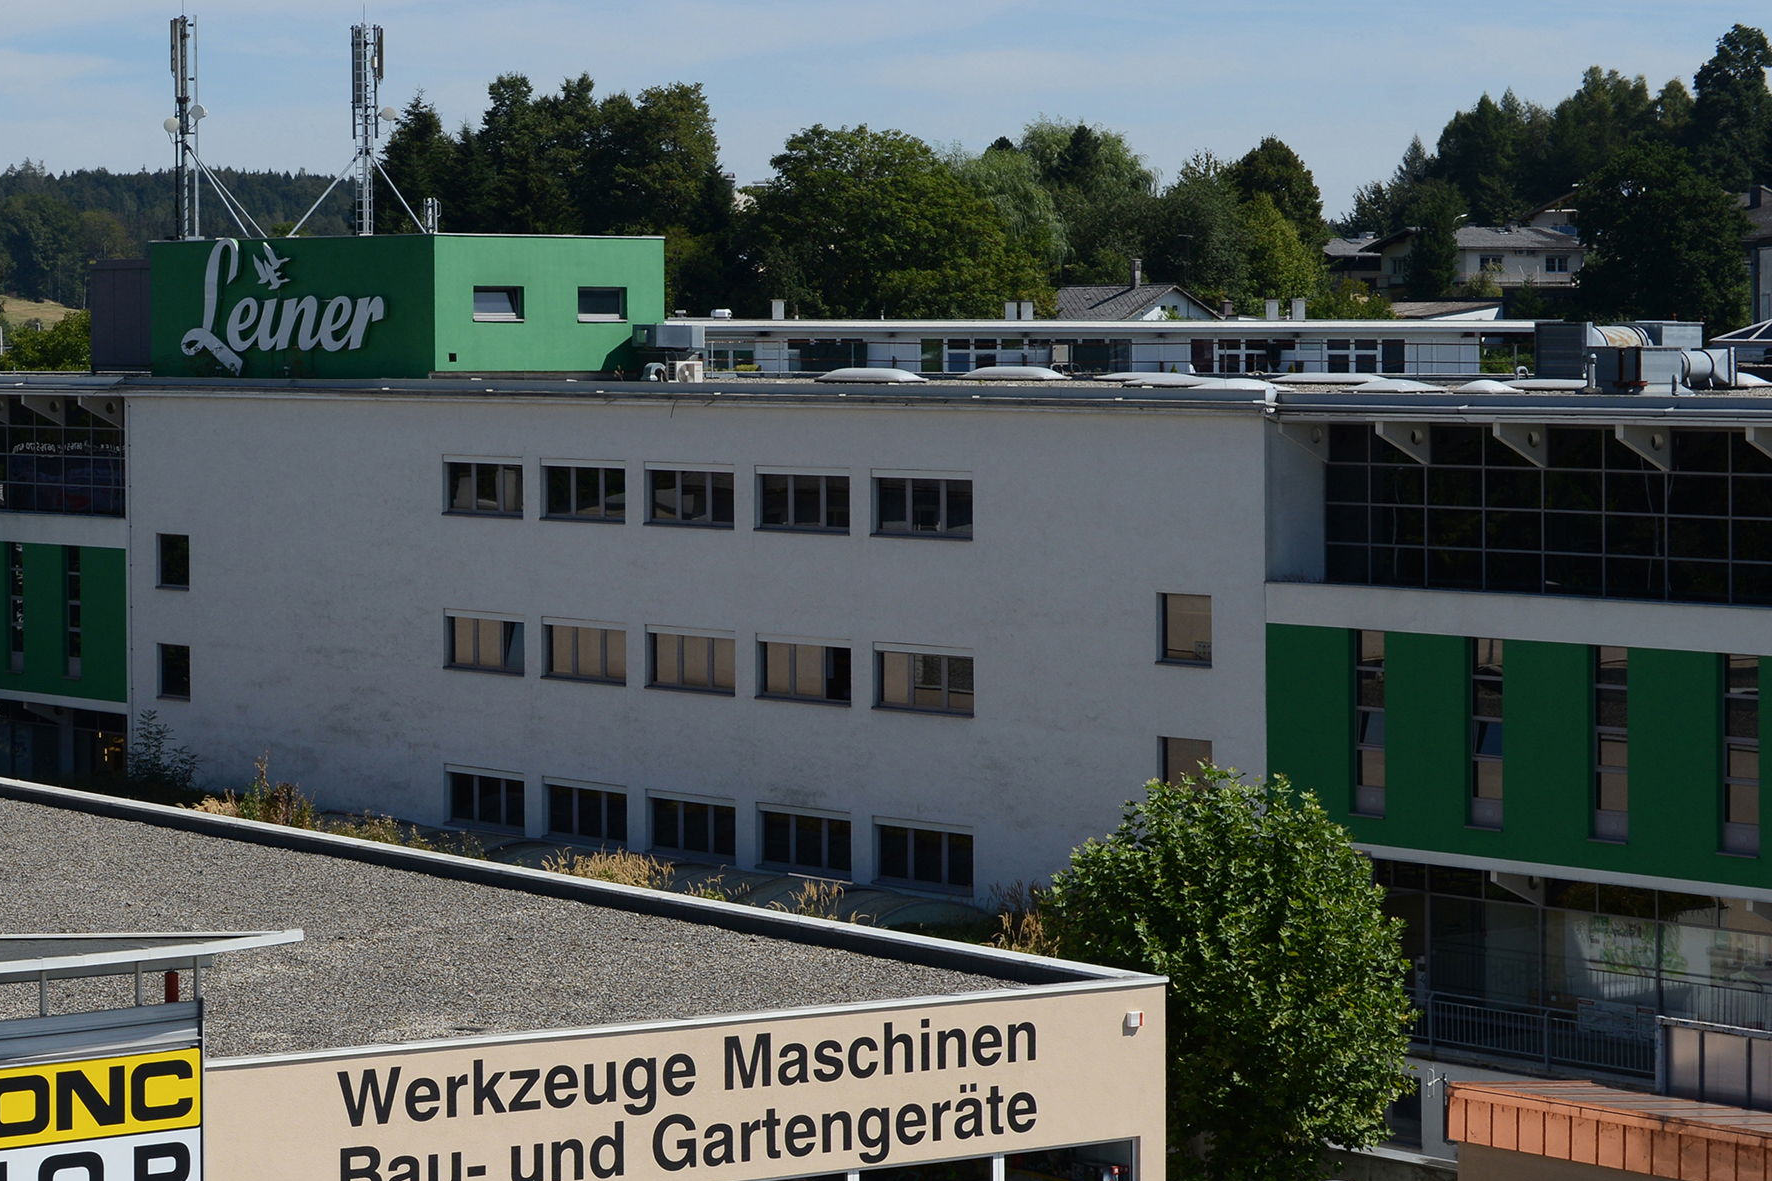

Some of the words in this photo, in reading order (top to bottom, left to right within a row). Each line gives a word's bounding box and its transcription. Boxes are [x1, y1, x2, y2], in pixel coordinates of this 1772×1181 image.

[181, 238, 385, 377] Leiner
[337, 1053, 697, 1128] Werkzeuge
[724, 1018, 1037, 1091] Maschinen
[652, 1083, 1038, 1172] Gartengeräte
